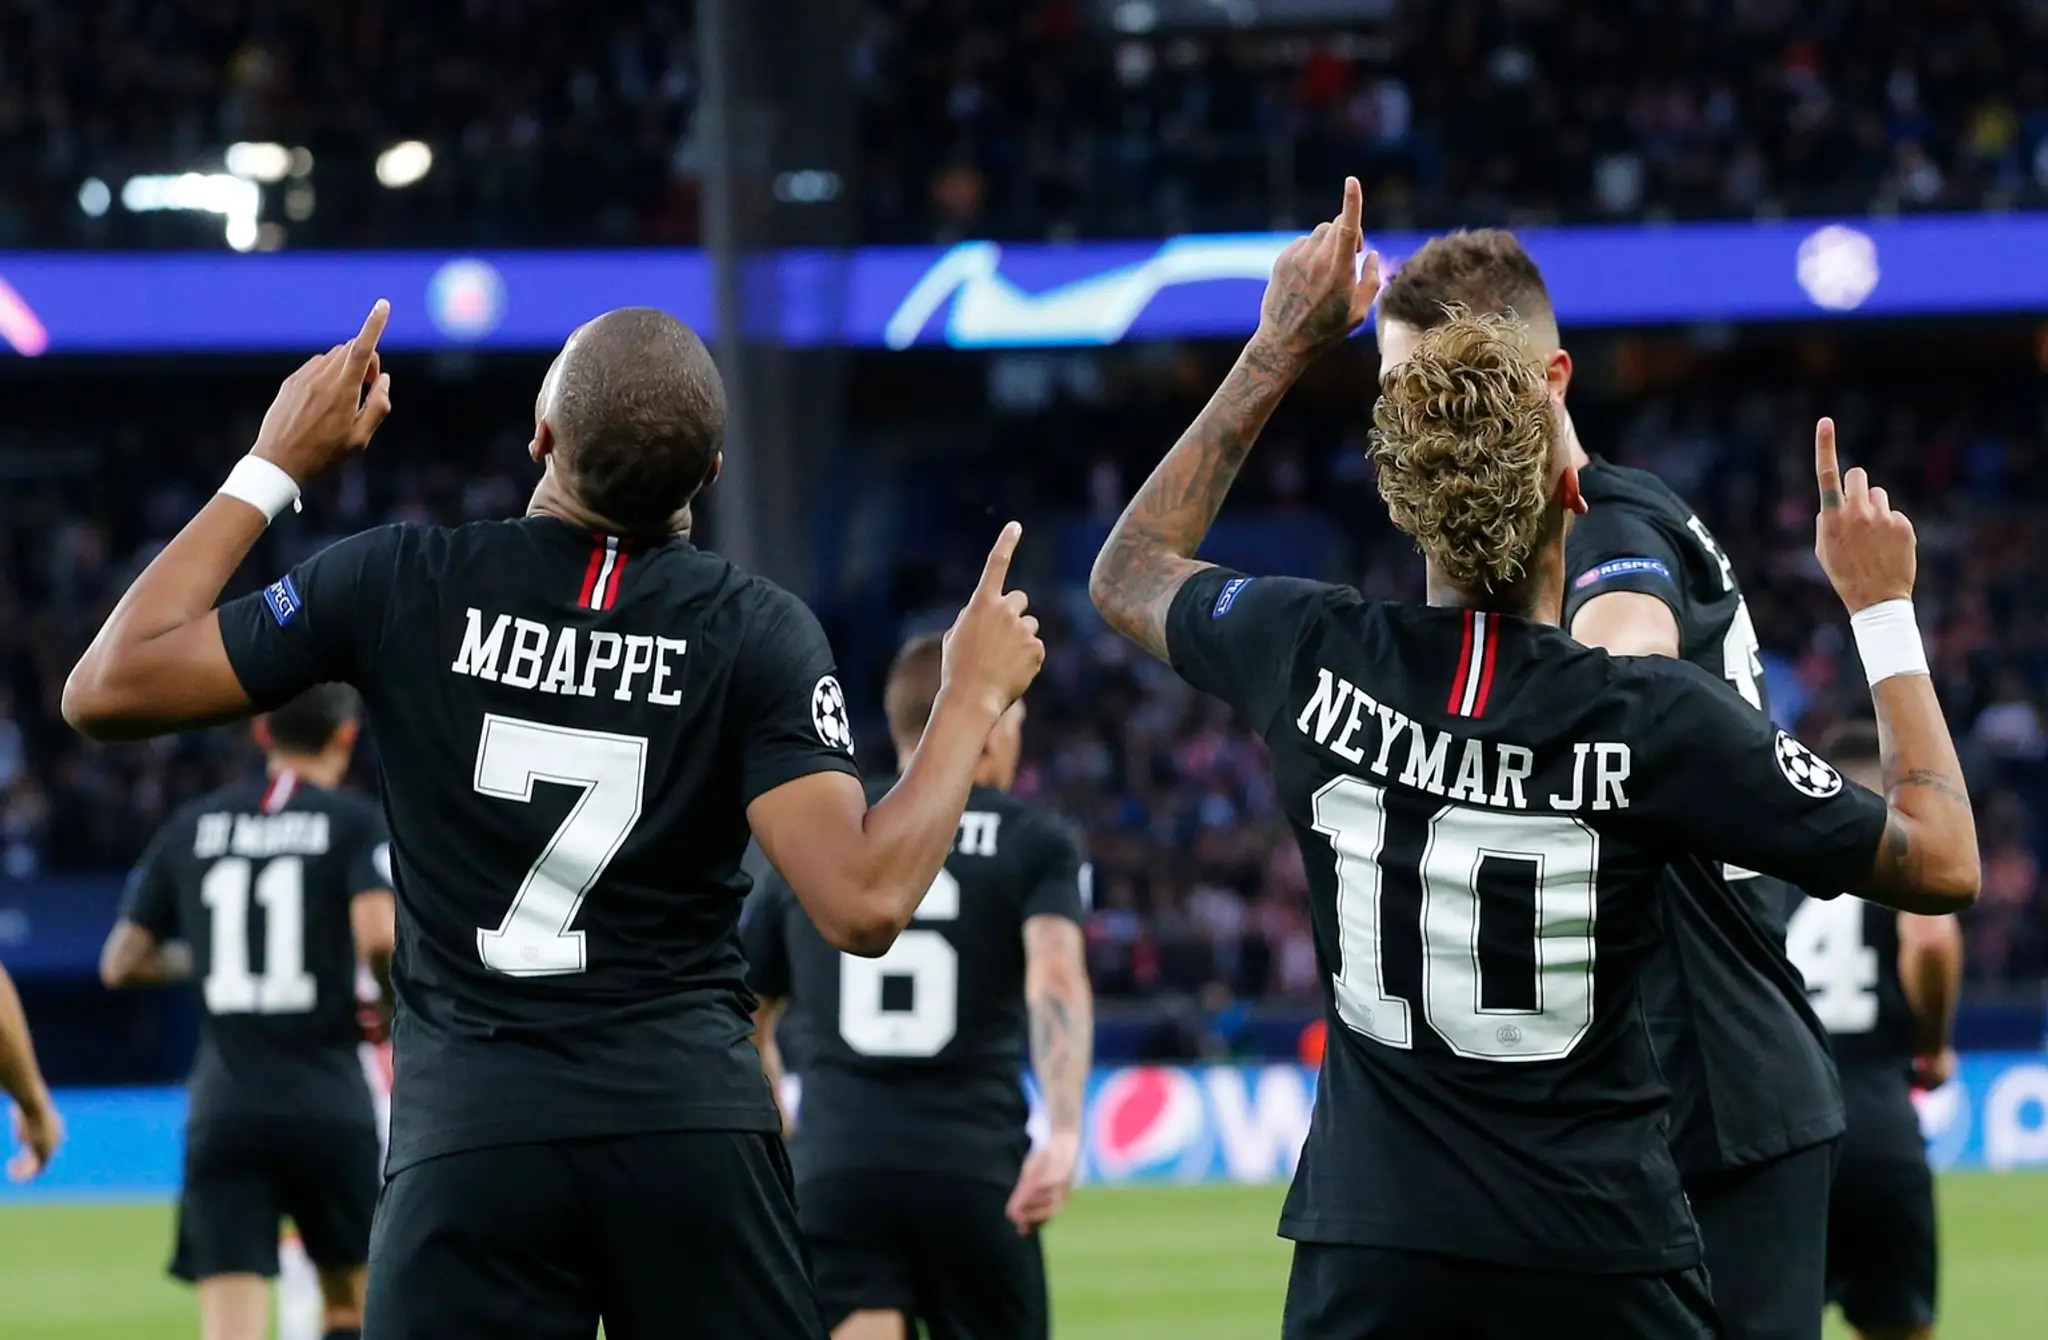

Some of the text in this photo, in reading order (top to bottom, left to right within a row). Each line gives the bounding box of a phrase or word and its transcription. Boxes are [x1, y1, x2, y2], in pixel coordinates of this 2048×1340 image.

[271, 581, 295, 617] PECT
[1601, 561, 1670, 577] RESPECT
[451, 607, 687, 706] MBAPPE
[1297, 668, 1631, 811] NEYMAR JR
[473, 712, 648, 978] 7
[201, 855, 318, 1015] 11
[839, 867, 960, 1058] 6
[1311, 773, 1600, 1062] 10
[1785, 892, 1879, 1033] 4
